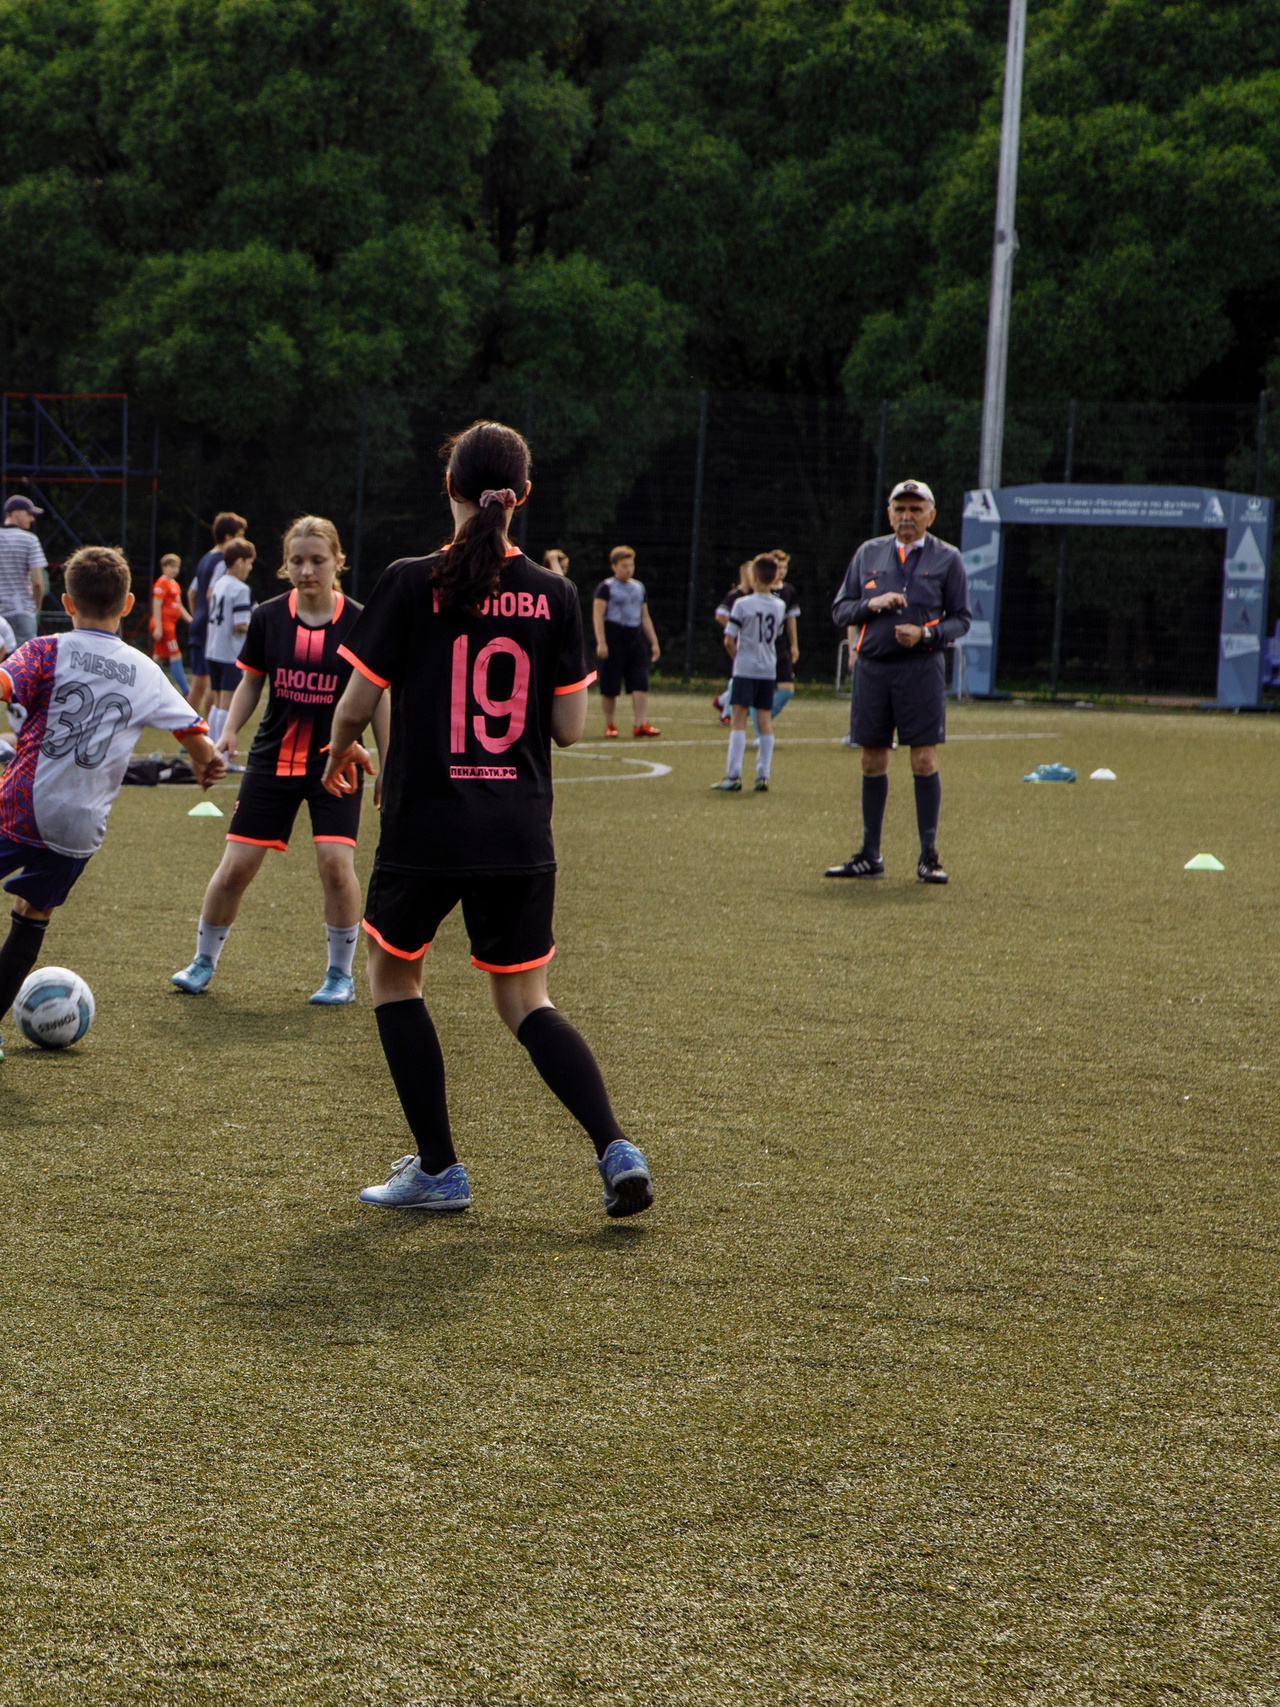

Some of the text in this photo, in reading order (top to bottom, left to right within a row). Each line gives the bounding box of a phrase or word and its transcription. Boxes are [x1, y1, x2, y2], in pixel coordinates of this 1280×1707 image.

[756, 611, 776, 643] 13
[69, 650, 137, 687] MESSI
[274, 667, 338, 692] ДЮСШ
[450, 634, 530, 754] 19
[40, 681, 132, 769] 30
[450, 767, 517, 779] ПЕНАЛЬТИ.РФ
